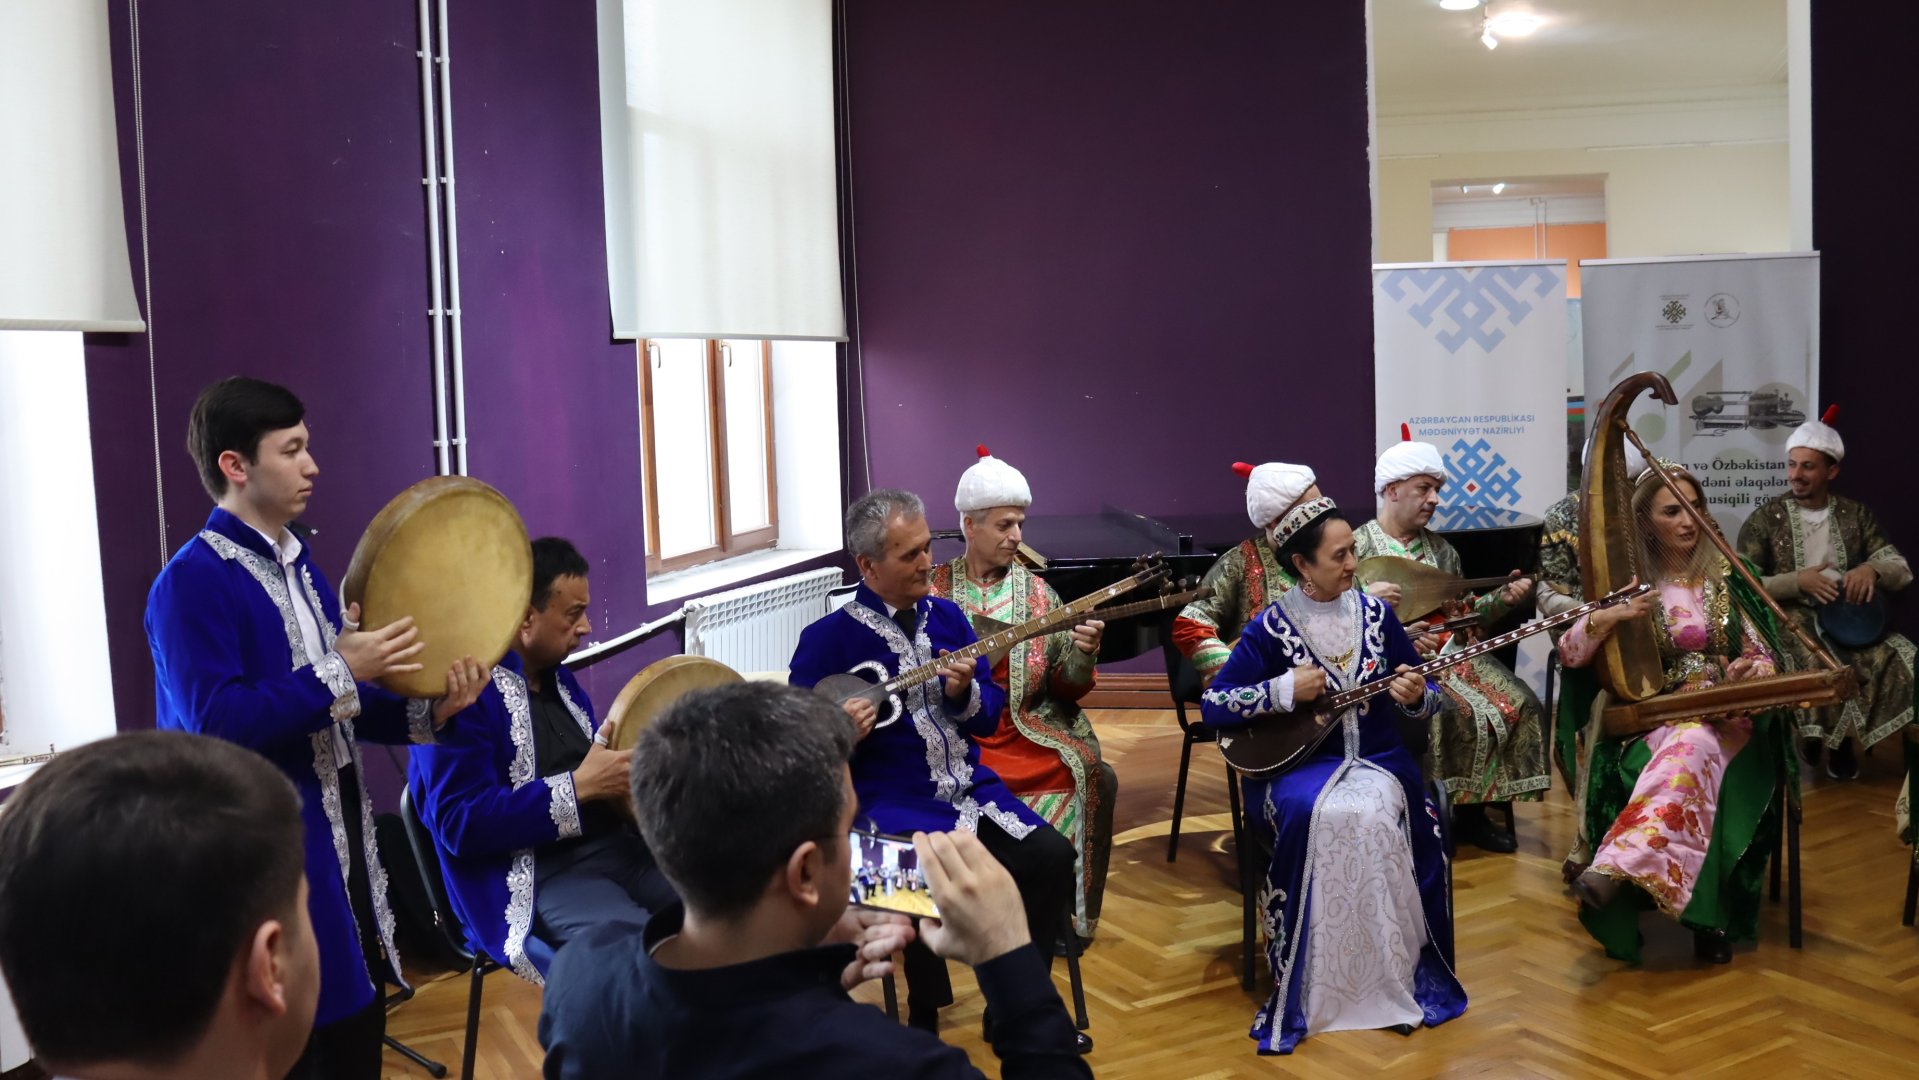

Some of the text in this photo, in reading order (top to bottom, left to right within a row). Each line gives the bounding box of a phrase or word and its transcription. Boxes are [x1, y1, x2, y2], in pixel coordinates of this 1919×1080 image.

[1409, 414, 1535, 424] AZƏRBAYCAN RESPUBLİKASI
[1419, 426, 1525, 436] MƏDƏNİYYƏT NAZİRLİYİ
[1693, 462, 1708, 471] və
[1712, 457, 1785, 470] Özbəkistan
[1701, 477, 1731, 488] dəni
[1705, 493, 1750, 507] usiqili
